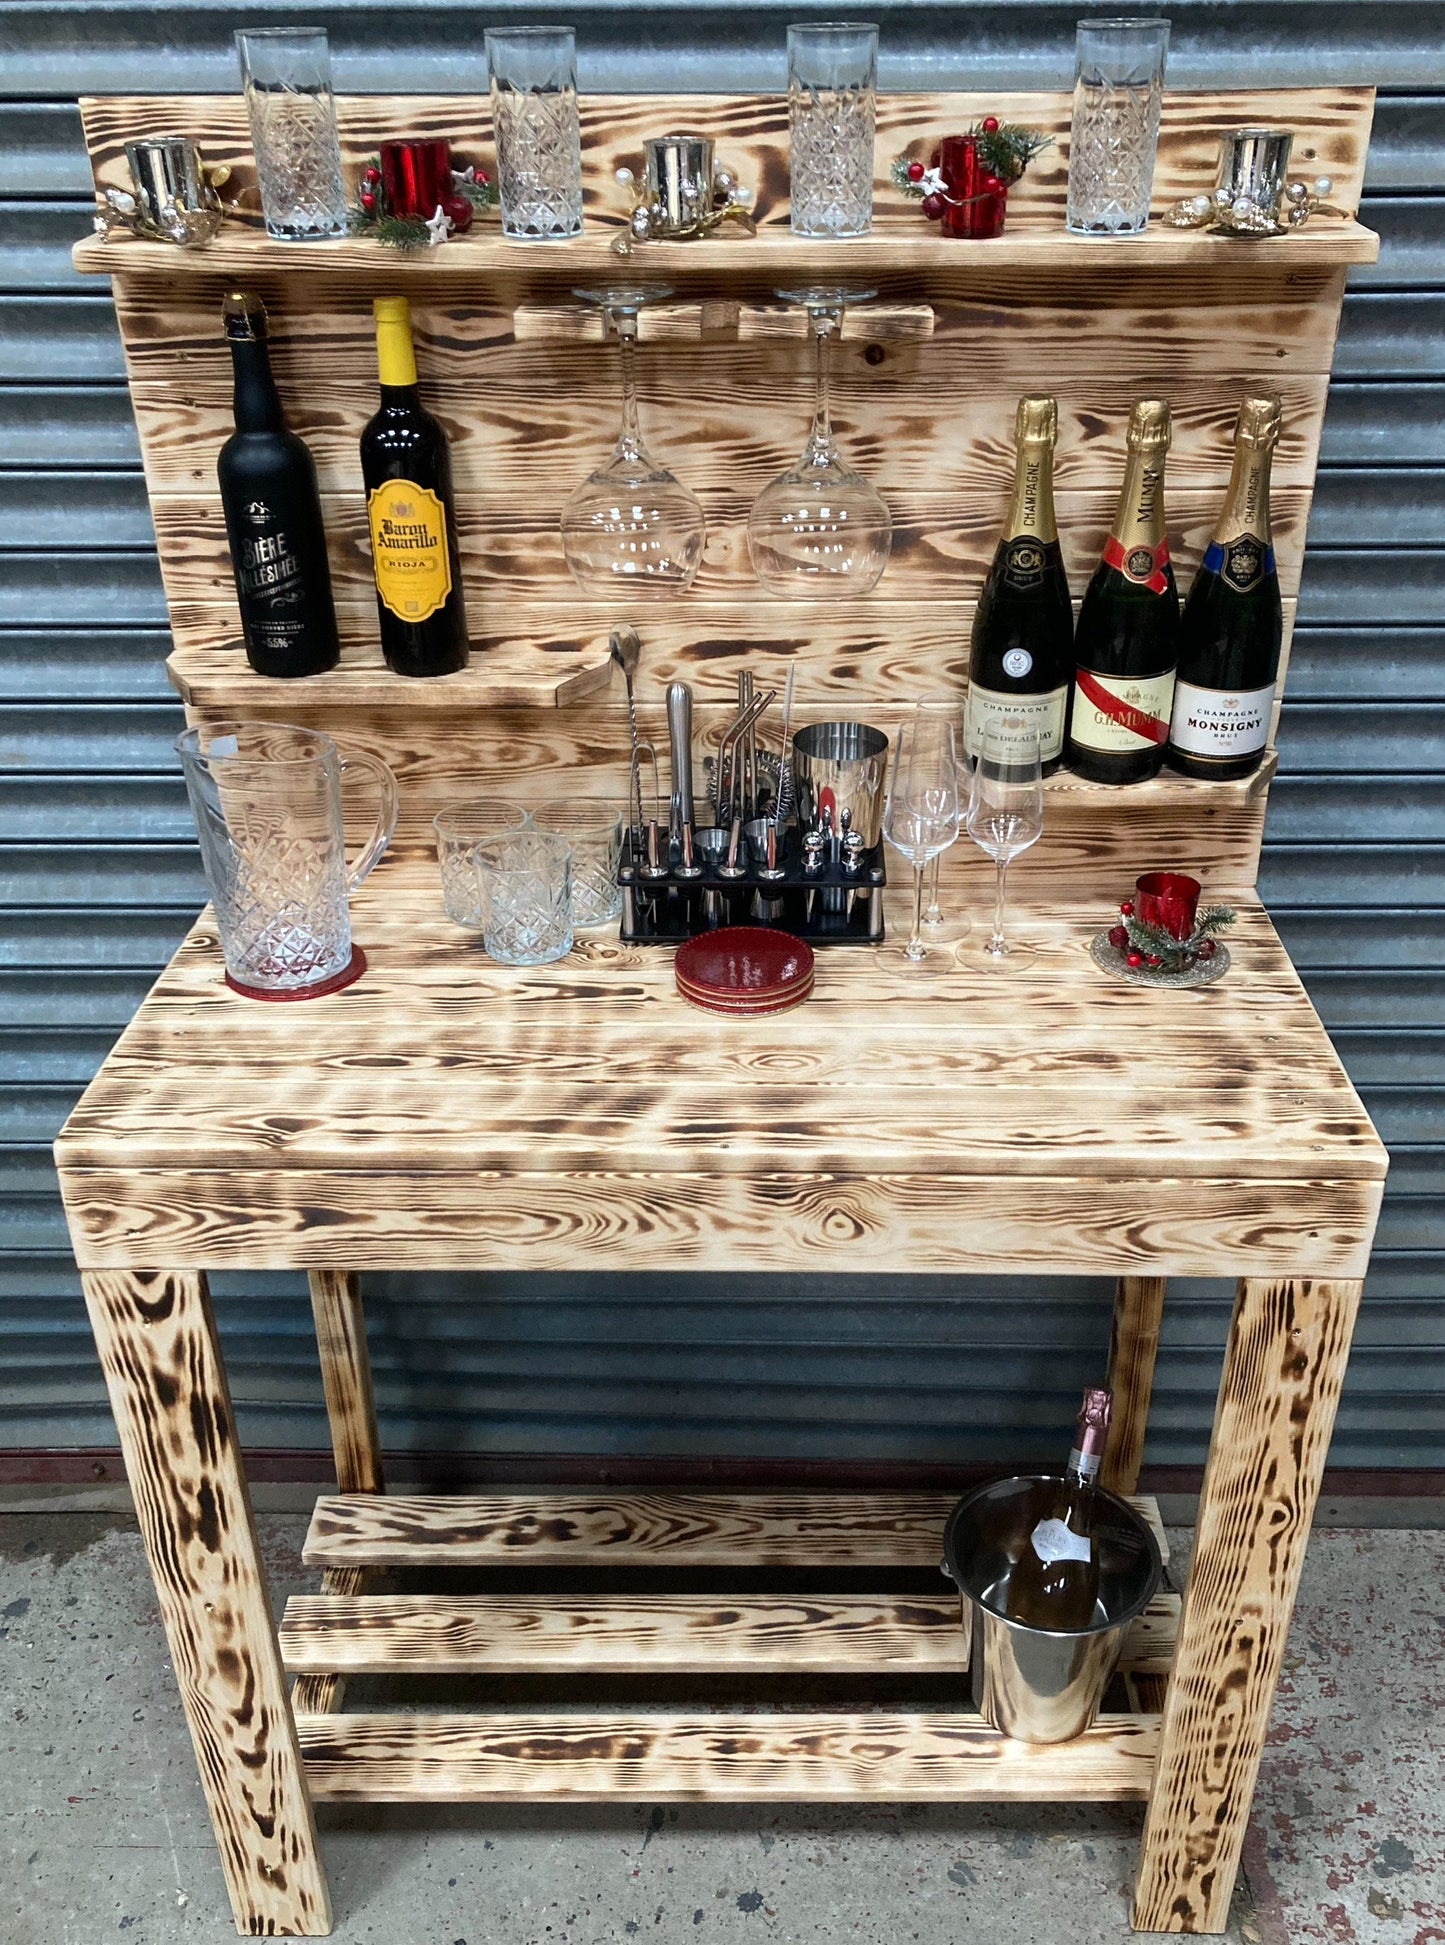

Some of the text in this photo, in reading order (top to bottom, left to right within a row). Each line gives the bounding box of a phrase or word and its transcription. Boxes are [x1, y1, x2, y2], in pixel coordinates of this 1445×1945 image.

[1024, 461, 1040, 527] CHAMPAGNE
[1136, 469, 1160, 523] MUMM
[1245, 466, 1260, 524] CHAMPAGNE
[381, 519, 428, 536] Baron
[378, 531, 438, 549] Amarillo
[984, 702, 1049, 713] CHAMPAGNE
[1197, 708, 1259, 717] CHAMPAGNE
[1187, 717, 1263, 732] MONSIGNY
